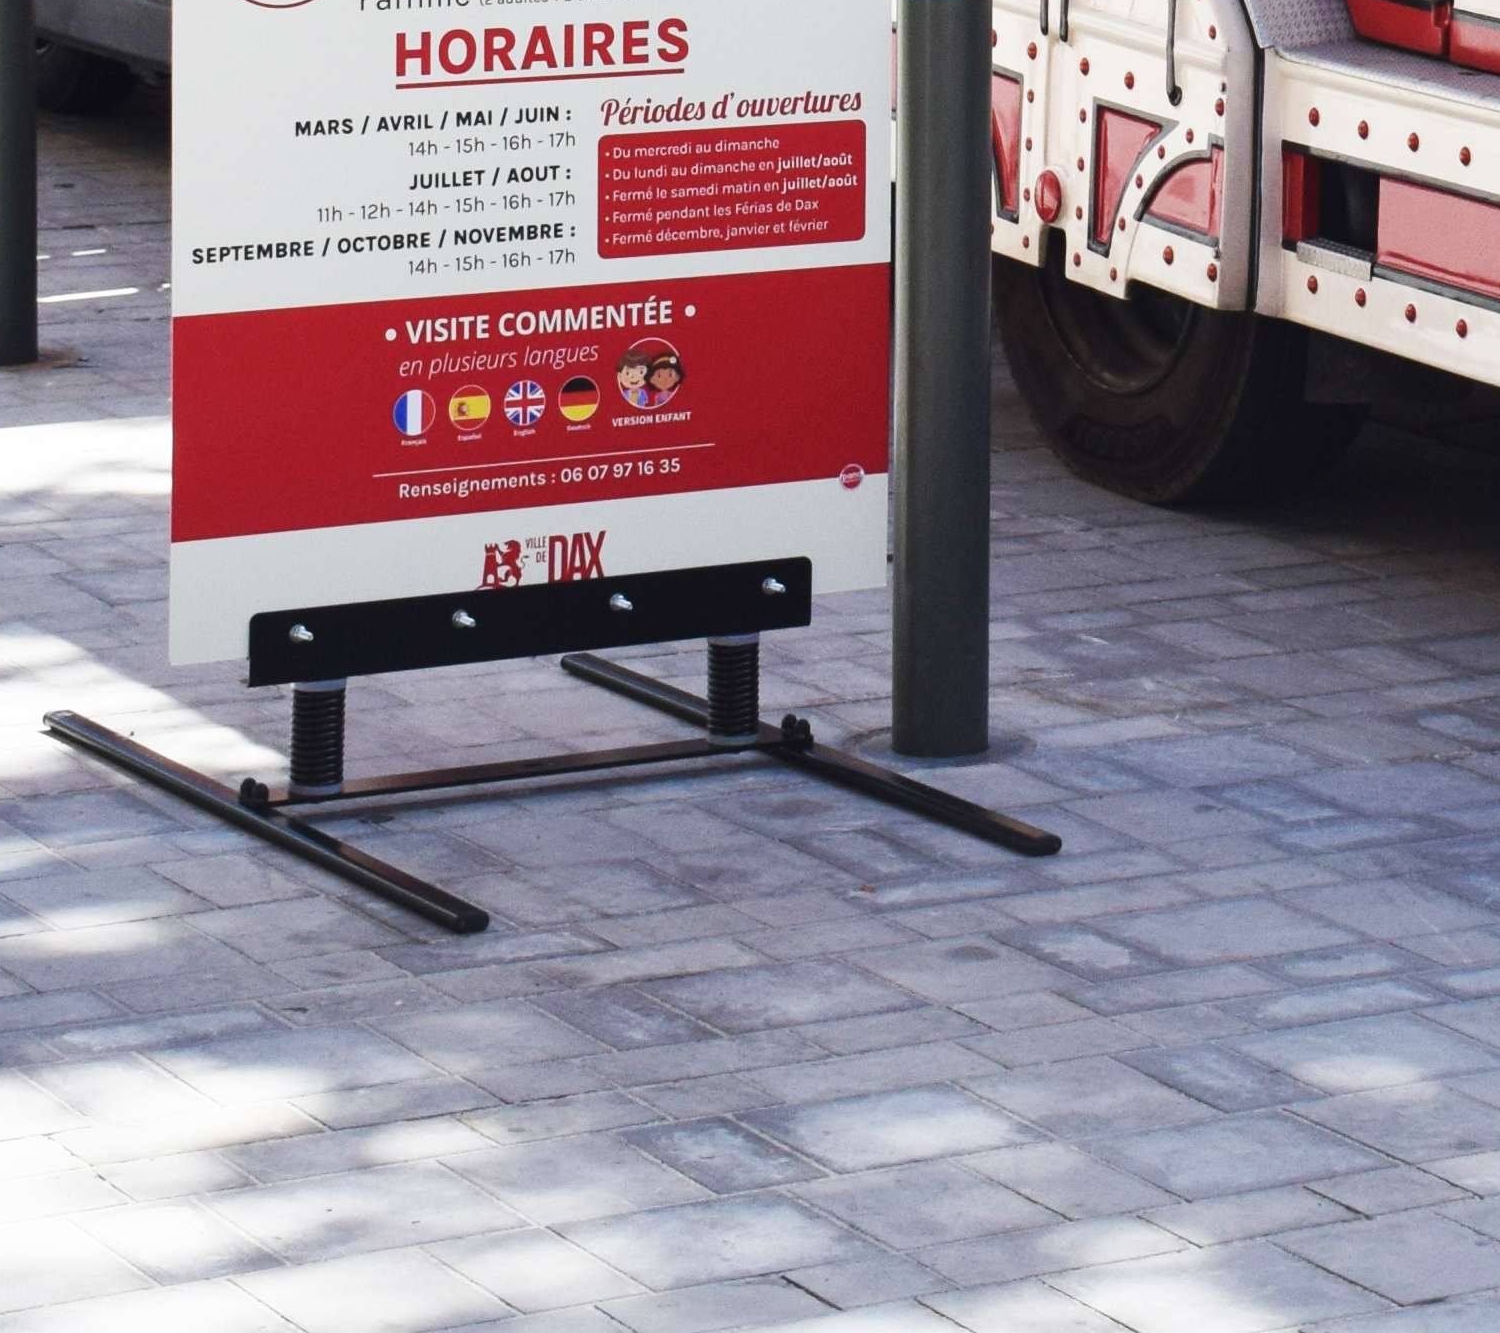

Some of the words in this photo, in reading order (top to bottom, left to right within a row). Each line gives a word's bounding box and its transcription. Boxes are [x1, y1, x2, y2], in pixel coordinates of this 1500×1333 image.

[396, 18, 689, 76] HORAIRES
[296, 118, 353, 137] MARS
[377, 114, 433, 132] AVRIL
[456, 110, 492, 127] MAI
[515, 106, 559, 124] JUIN
[601, 97, 705, 126] Périodes
[409, 140, 437, 156] 14h
[457, 137, 484, 153] 15h
[503, 134, 531, 150] 16h
[550, 132, 575, 147] 17h
[614, 147, 630, 158] Du
[635, 142, 691, 157] mercredi
[696, 144, 711, 153] au
[715, 137, 779, 152] dimanche
[409, 170, 485, 190] JUILLET
[507, 165, 560, 183] AOUT
[613, 169, 630, 180] Du
[634, 164, 667, 179] lundi
[671, 166, 687, 178] au
[691, 160, 755, 175] dimanche
[759, 161, 774, 171] en
[776, 153, 852, 173] juillet/août
[613, 187, 652, 201] Fermé
[657, 185, 668, 200] le
[671, 183, 719, 198] samedi
[723, 181, 760, 194] matin
[764, 182, 779, 191] en
[781, 174, 857, 194] juillet/août
[318, 206, 342, 222] 11h
[361, 203, 390, 219] 12h
[409, 200, 437, 216] 14h
[456, 197, 484, 213] 15h
[503, 194, 530, 210] 16h
[550, 191, 575, 206] 17h
[613, 208, 652, 223] Fermé
[657, 207, 710, 224] pendant
[714, 205, 731, 216] les
[736, 201, 772, 214] Férias
[776, 199, 792, 213] de
[796, 199, 818, 210] Dax
[192, 241, 314, 264] SEPTEMBRE
[338, 232, 430, 254] OCTOBRE
[454, 223, 563, 245] NOVEMBRE
[613, 230, 652, 244] Fermé
[656, 227, 723, 242] décembre,
[725, 223, 770, 240] janvier
[773, 223, 785, 233] et
[789, 219, 828, 232] février
[409, 258, 437, 275] 14h
[456, 255, 484, 271] 15h
[503, 252, 530, 268] 16h
[549, 248, 574, 264] 17h
[406, 315, 489, 344] VISITE
[499, 296, 672, 336] COMMENTÉE
[400, 360, 422, 376] en
[428, 351, 517, 380] plusieurs
[524, 346, 598, 369] langues
[612, 415, 653, 427] VERSION
[656, 412, 691, 423] ENFANT
[399, 473, 546, 498] Renseignements
[561, 467, 582, 482] 06
[588, 465, 608, 480] 07
[613, 463, 633, 477] 97
[638, 461, 654, 475] 16
[660, 458, 680, 473] 35
[525, 538, 547, 550] VILLE
[536, 551, 546, 562] DE
[547, 531, 606, 579] DAX
